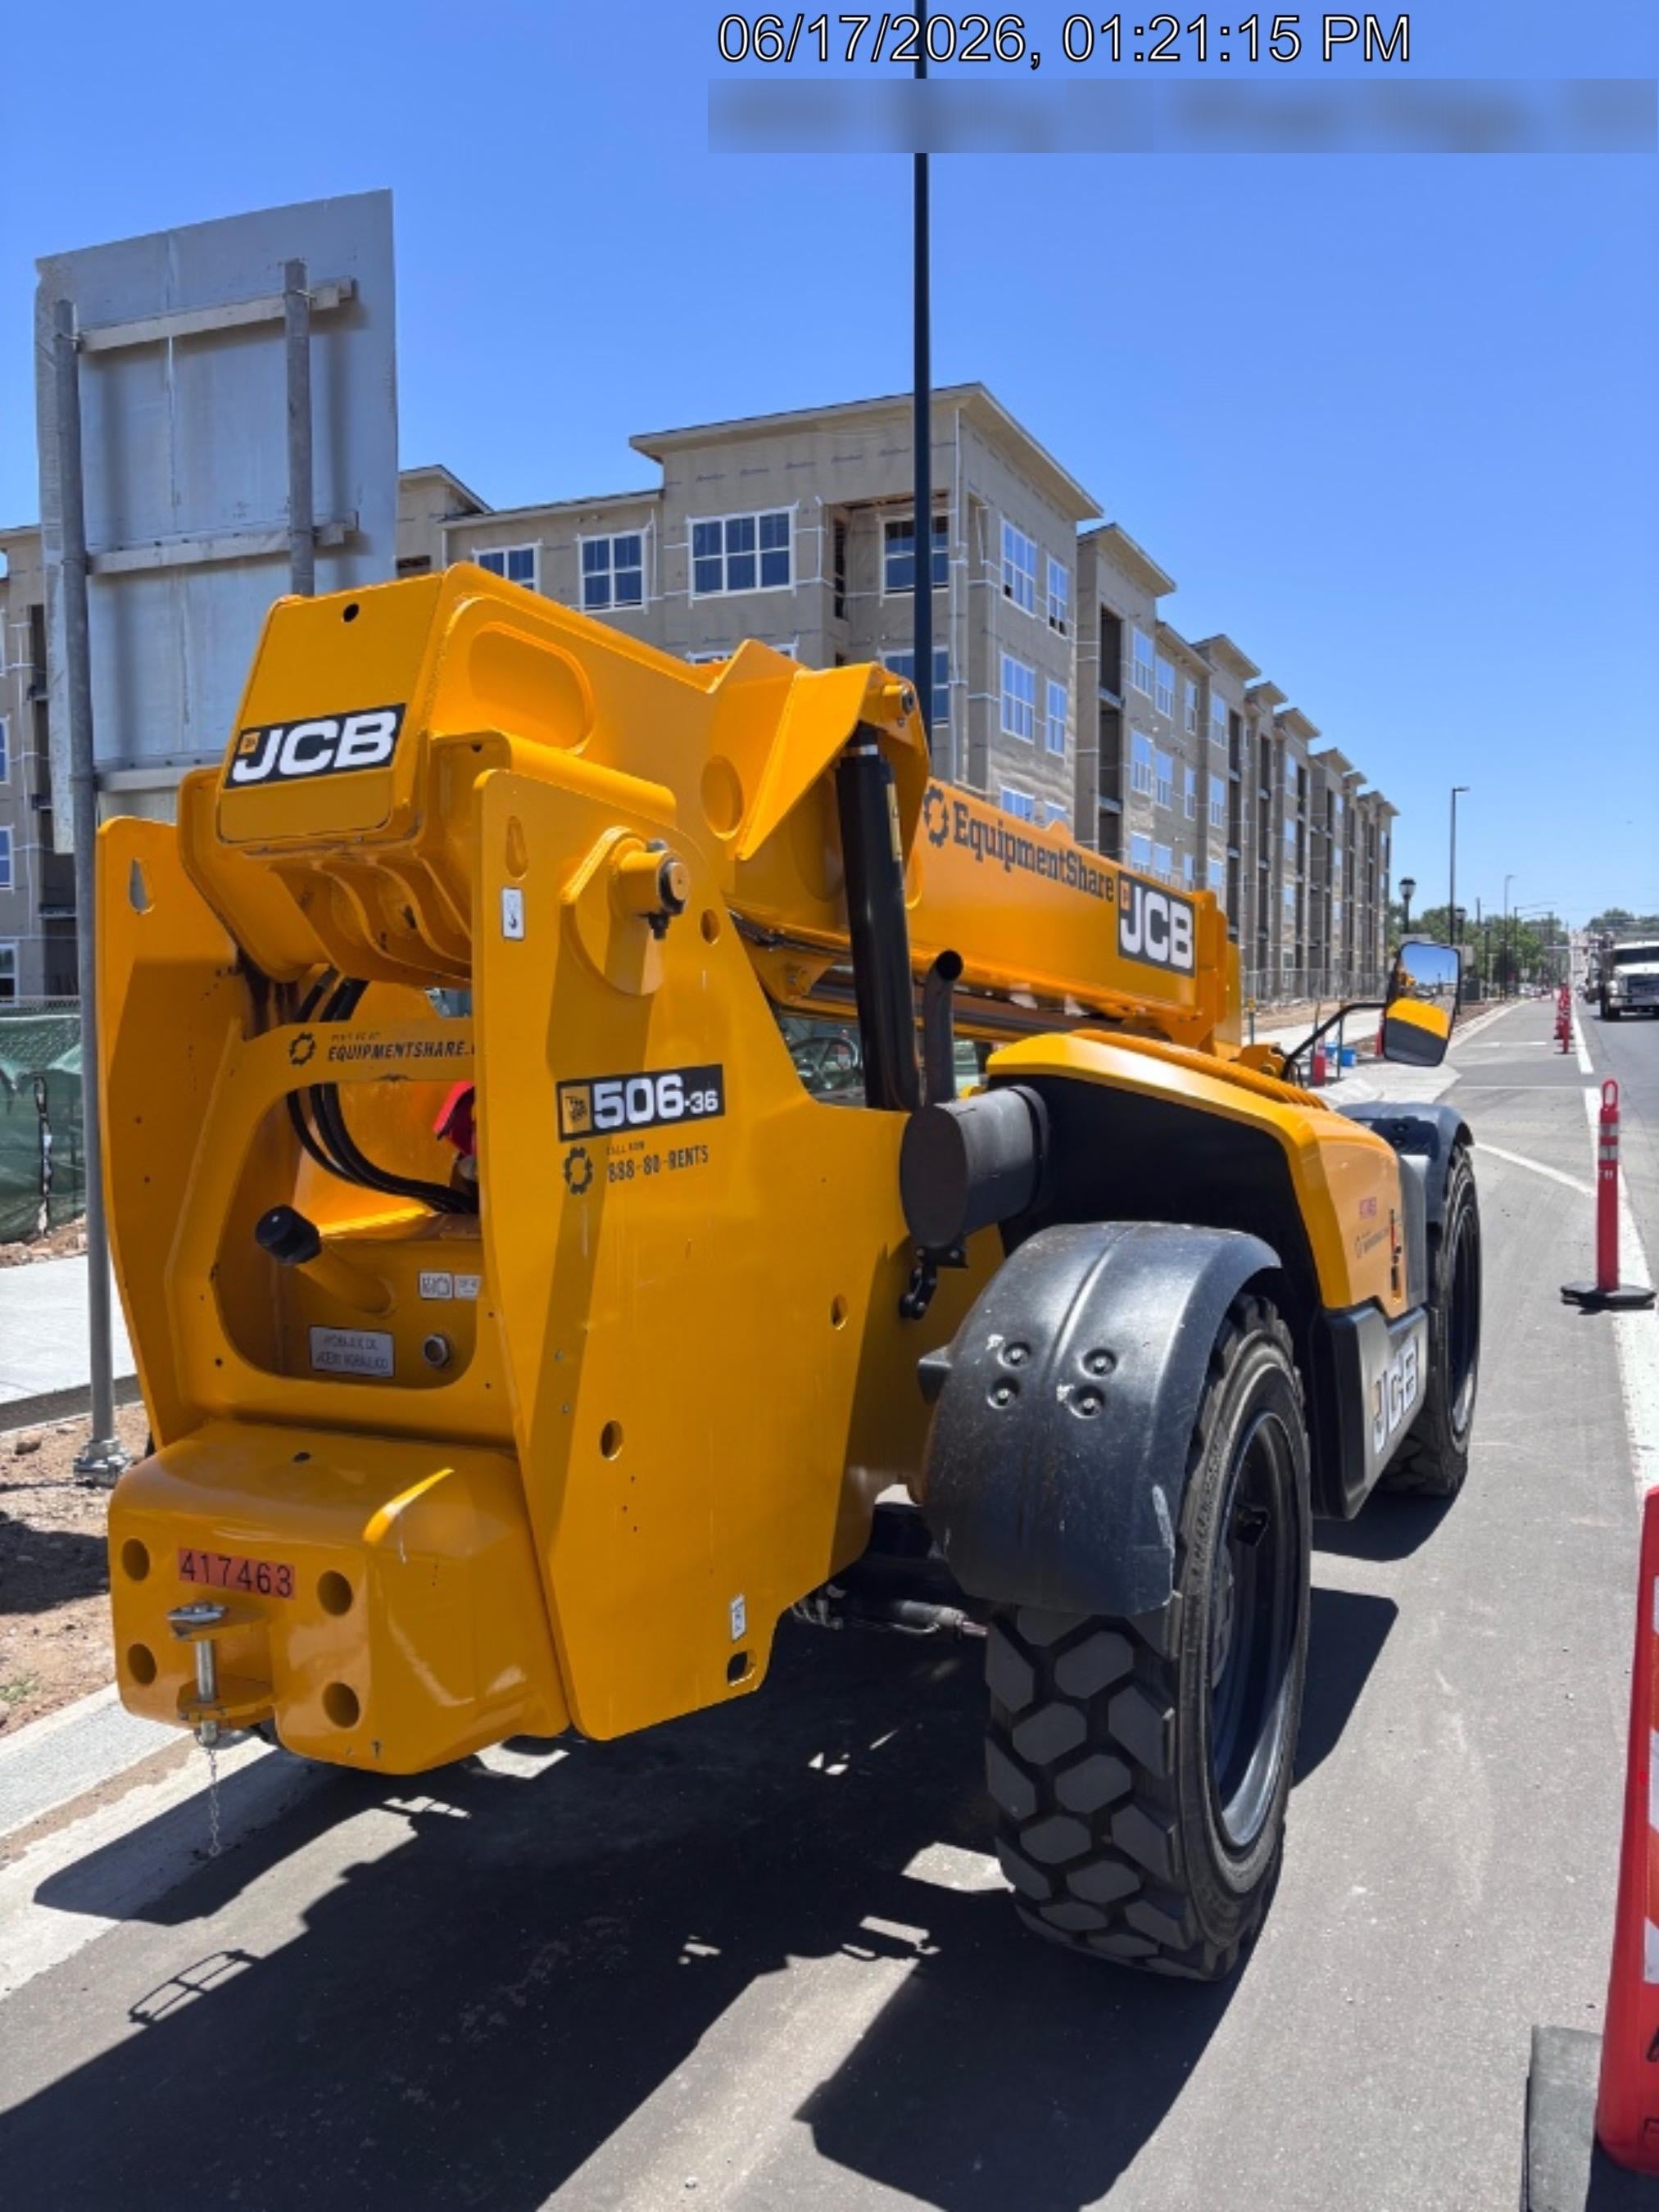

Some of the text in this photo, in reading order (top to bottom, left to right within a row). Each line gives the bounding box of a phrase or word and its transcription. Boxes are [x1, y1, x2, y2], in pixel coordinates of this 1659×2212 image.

[232, 710, 397, 782] JCB
[952, 800, 1115, 903] EquipmentShare
[1119, 885, 1194, 969] JCB
[1373, 1335, 1418, 1455] JCB
[181, 1552, 292, 1598] 417463
